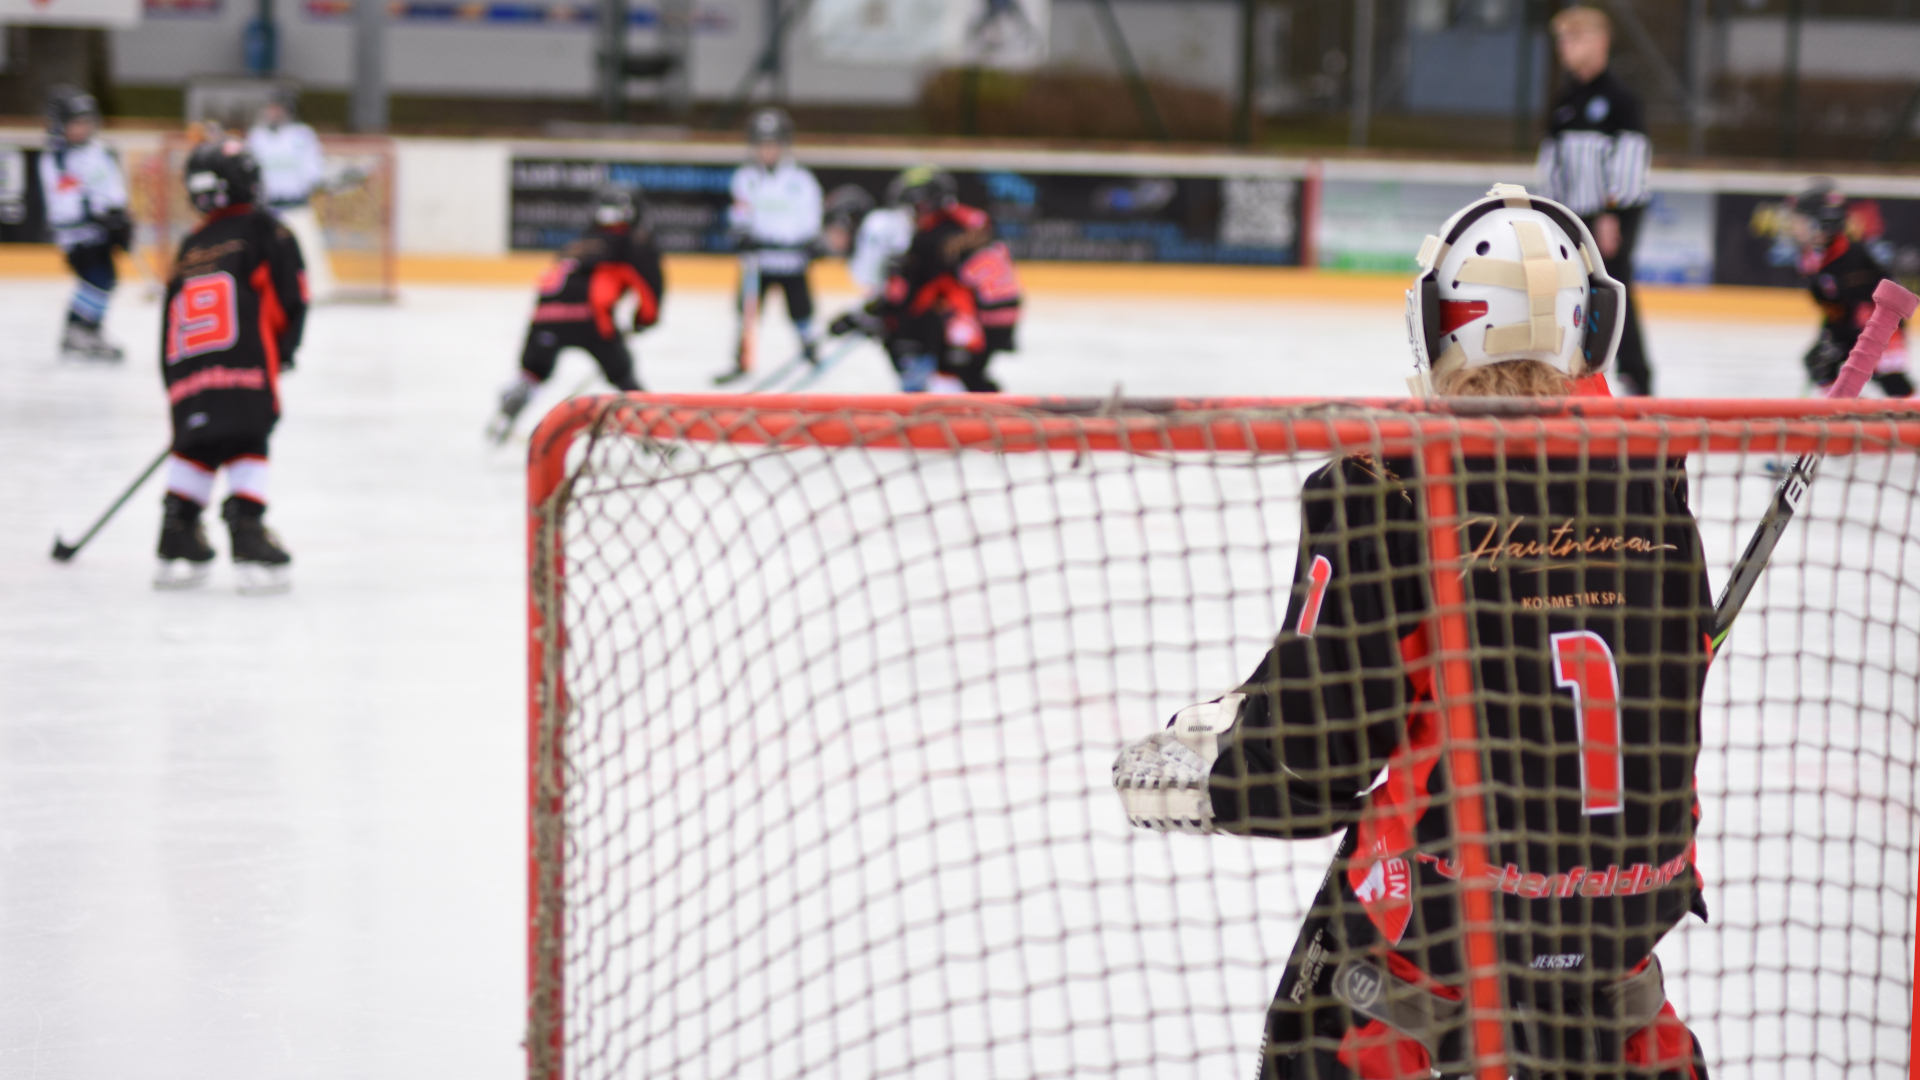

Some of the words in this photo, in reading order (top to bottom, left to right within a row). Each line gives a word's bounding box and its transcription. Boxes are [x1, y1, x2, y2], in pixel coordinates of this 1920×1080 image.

[1452, 516, 1678, 582] Hautniveau
[1297, 554, 1332, 638] 1
[1550, 630, 1624, 815] 1
